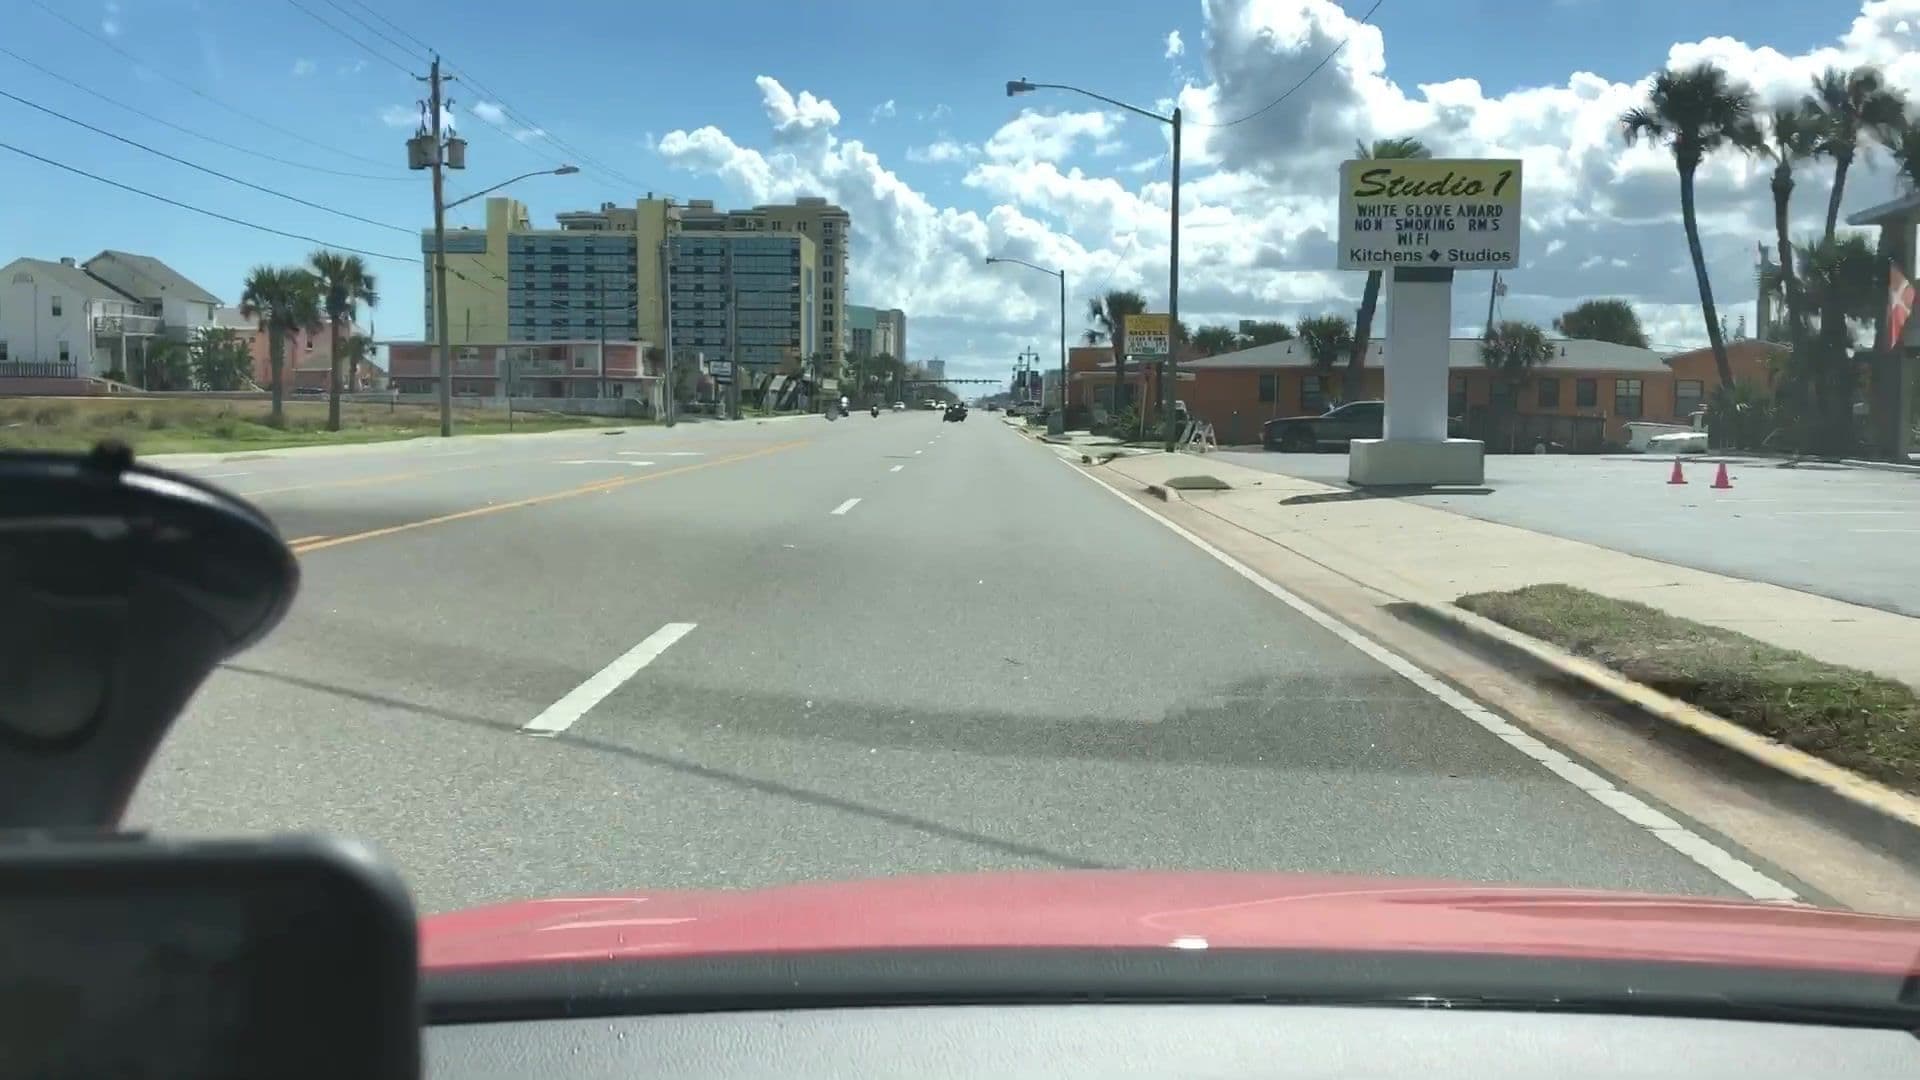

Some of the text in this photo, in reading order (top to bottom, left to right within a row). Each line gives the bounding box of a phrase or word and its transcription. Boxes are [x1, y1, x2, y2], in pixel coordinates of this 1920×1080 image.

[1354, 169, 1513, 197] Studio 1
[1357, 204, 1503, 217] WHITE GLOVE AWARD
[1355, 219, 1382, 231] NON
[1395, 219, 1455, 231] SMOKING
[1350, 249, 1511, 262] Kitchens Studios
